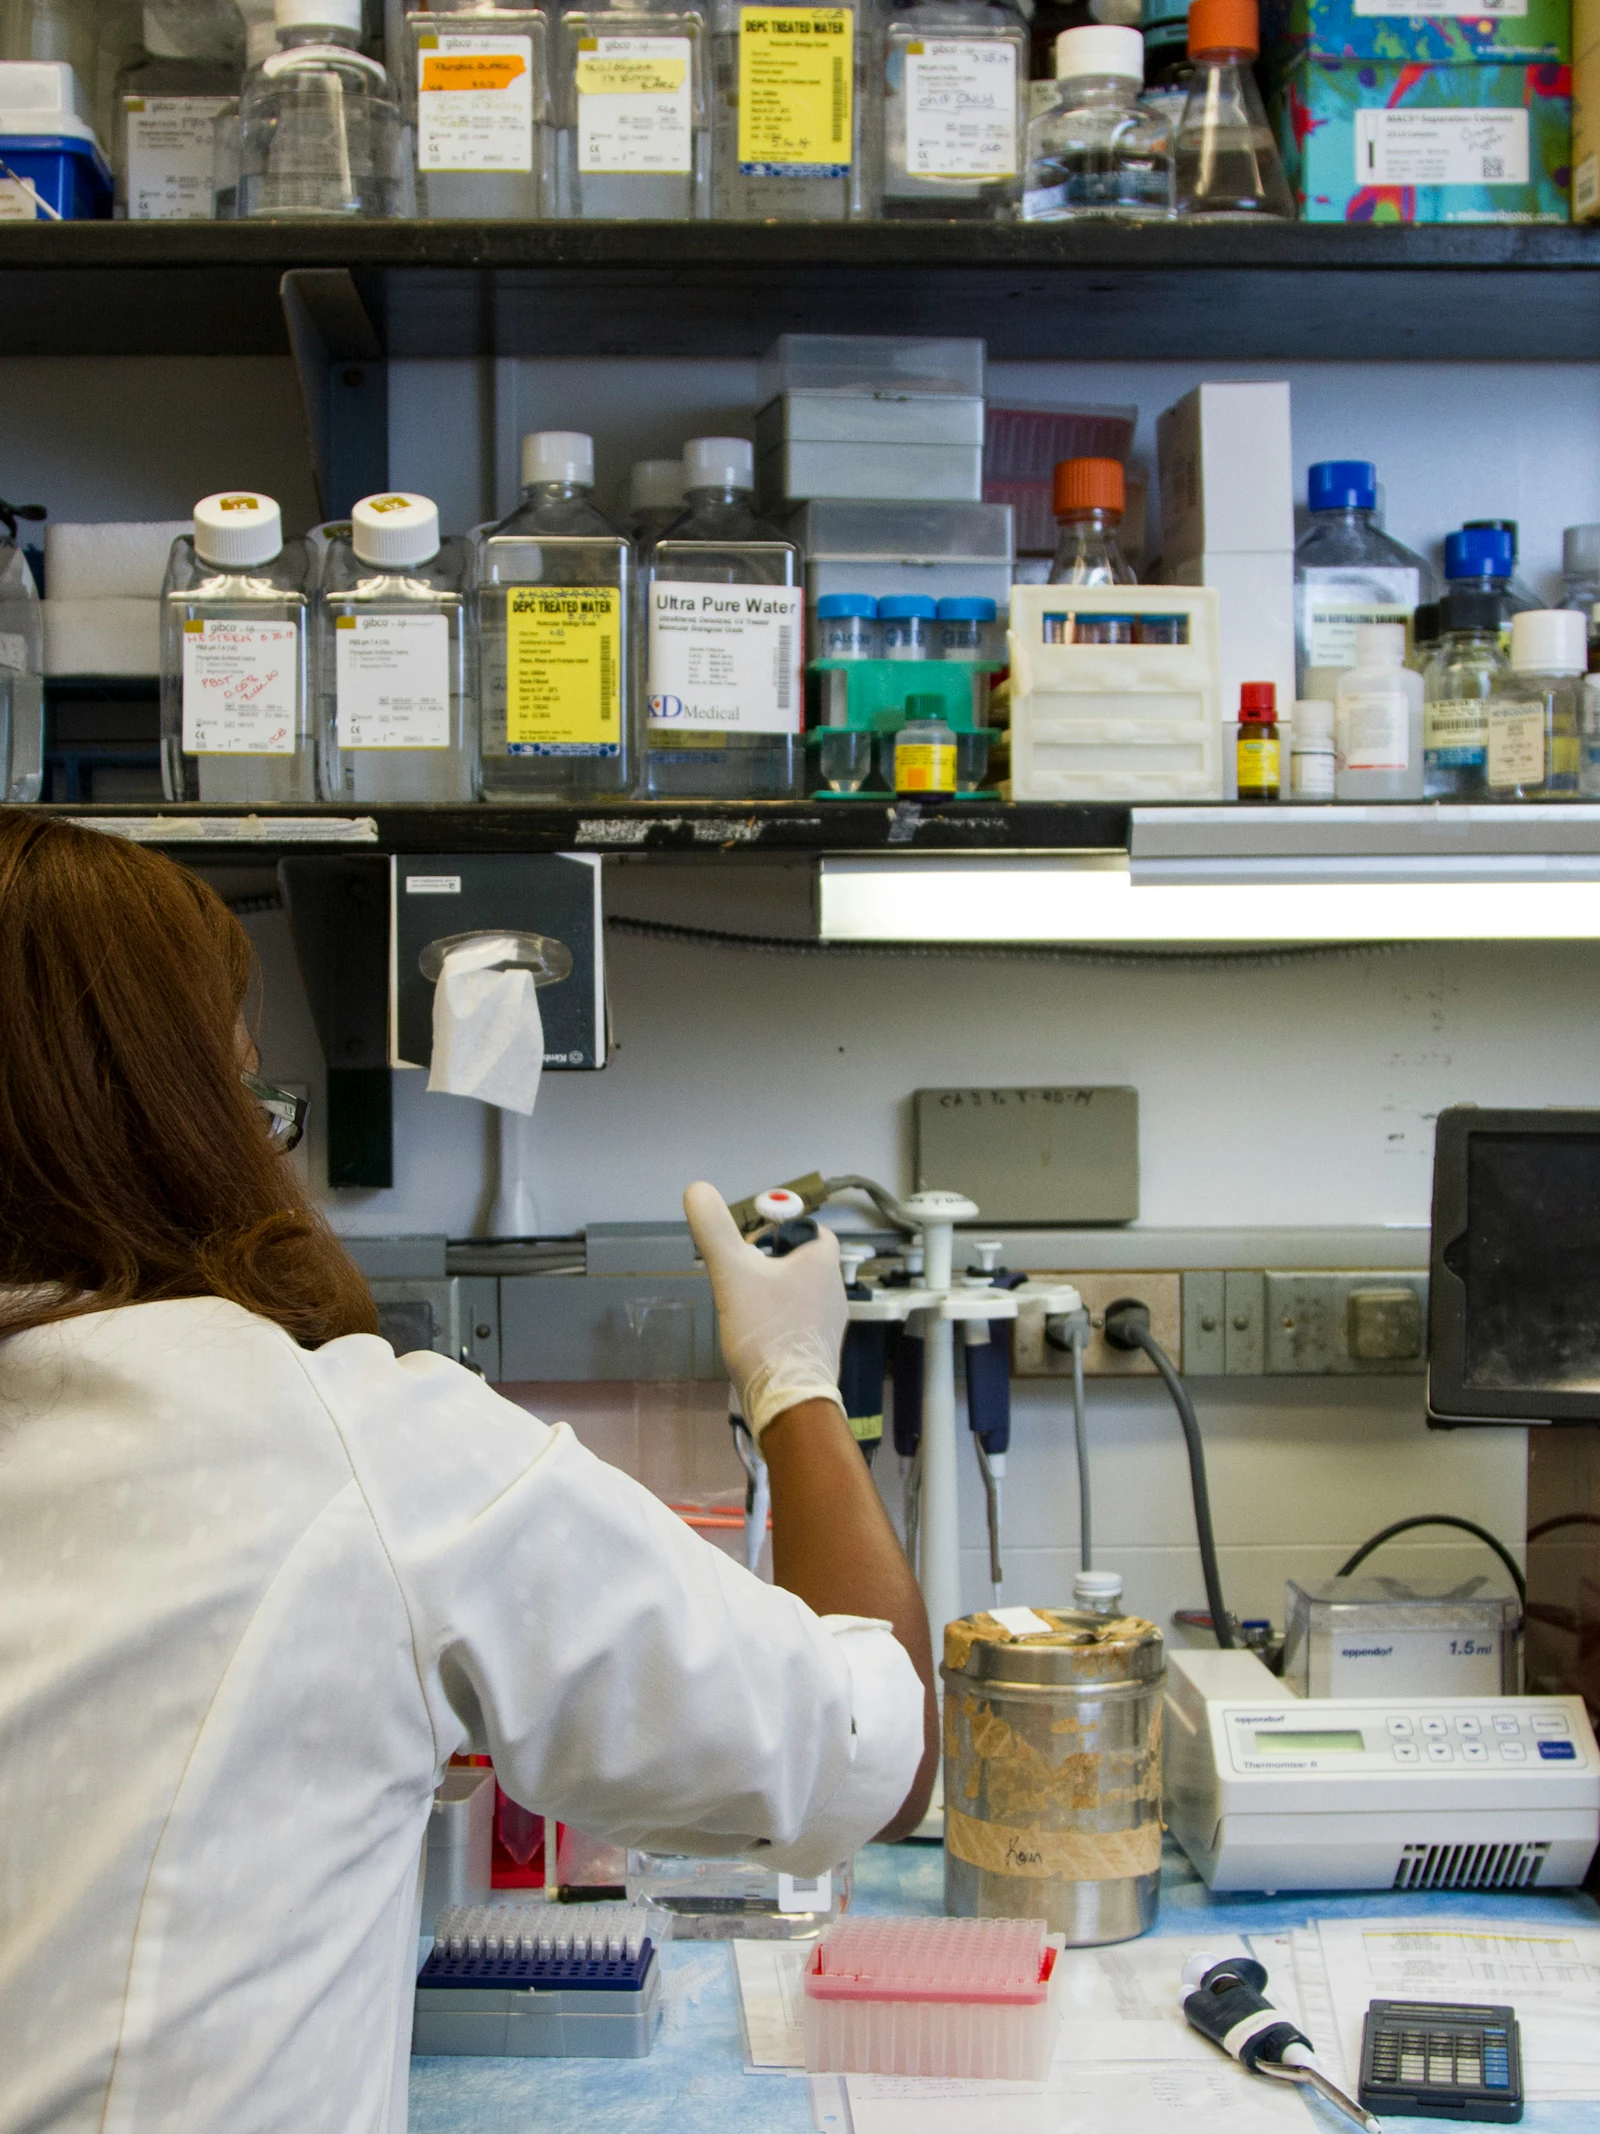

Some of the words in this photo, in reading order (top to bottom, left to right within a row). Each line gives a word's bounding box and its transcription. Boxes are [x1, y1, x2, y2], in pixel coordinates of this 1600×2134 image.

[745, 20, 769, 33] DEPC
[771, 20, 811, 34] TREATED
[813, 20, 844, 34] WATER
[604, 39, 631, 52] gibco
[512, 600, 536, 613] DEPC
[538, 600, 579, 613] TREATED
[580, 600, 612, 613] WATER
[656, 594, 696, 611] Ultra
[702, 596, 741, 612] Pure
[745, 597, 797, 615] Water
[210, 622, 237, 635] gibco
[362, 617, 389, 630] gibco
[187, 633, 253, 643] WESTERN
[202, 674, 233, 689] PBST
[684, 704, 741, 721] Medical
[1341, 1646, 1393, 1660] eppendorf
[1449, 1640, 1476, 1657] 1.5
[1234, 1714, 1286, 1725] eppendorf
[1243, 1760, 1308, 1771] Thermomixer
[1310, 1760, 1318, 1770] R
